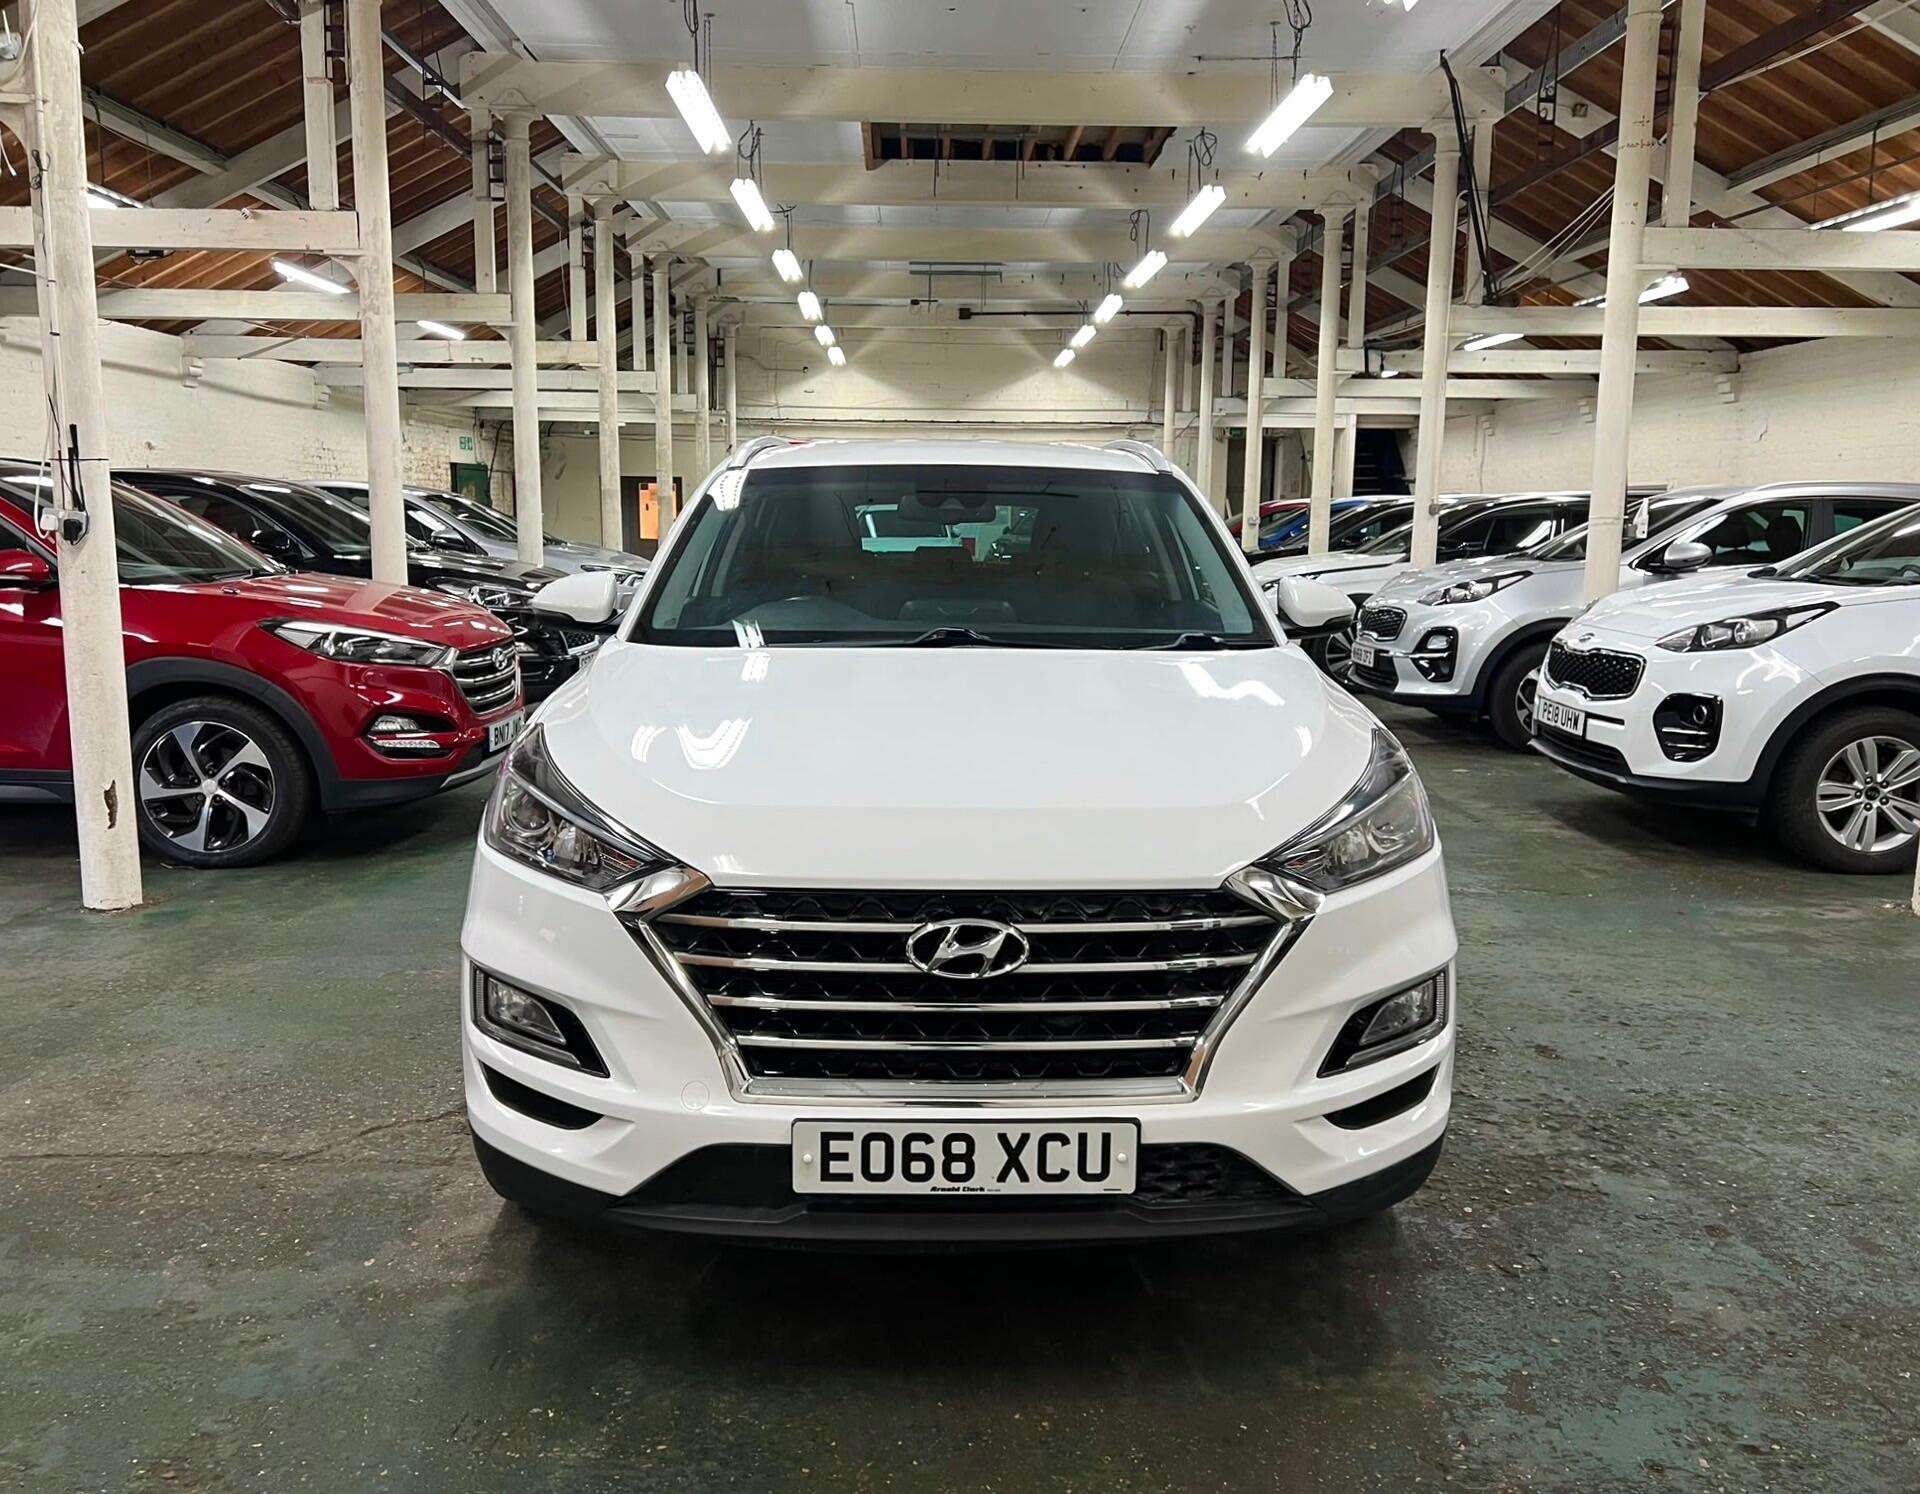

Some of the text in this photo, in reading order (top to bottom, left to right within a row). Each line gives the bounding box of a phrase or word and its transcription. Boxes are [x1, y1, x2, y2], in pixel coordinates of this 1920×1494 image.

[1541, 701, 1580, 731] PE18 UHW
[495, 723, 509, 746] BN17
[820, 1131, 1112, 1183] EO68 XCU
